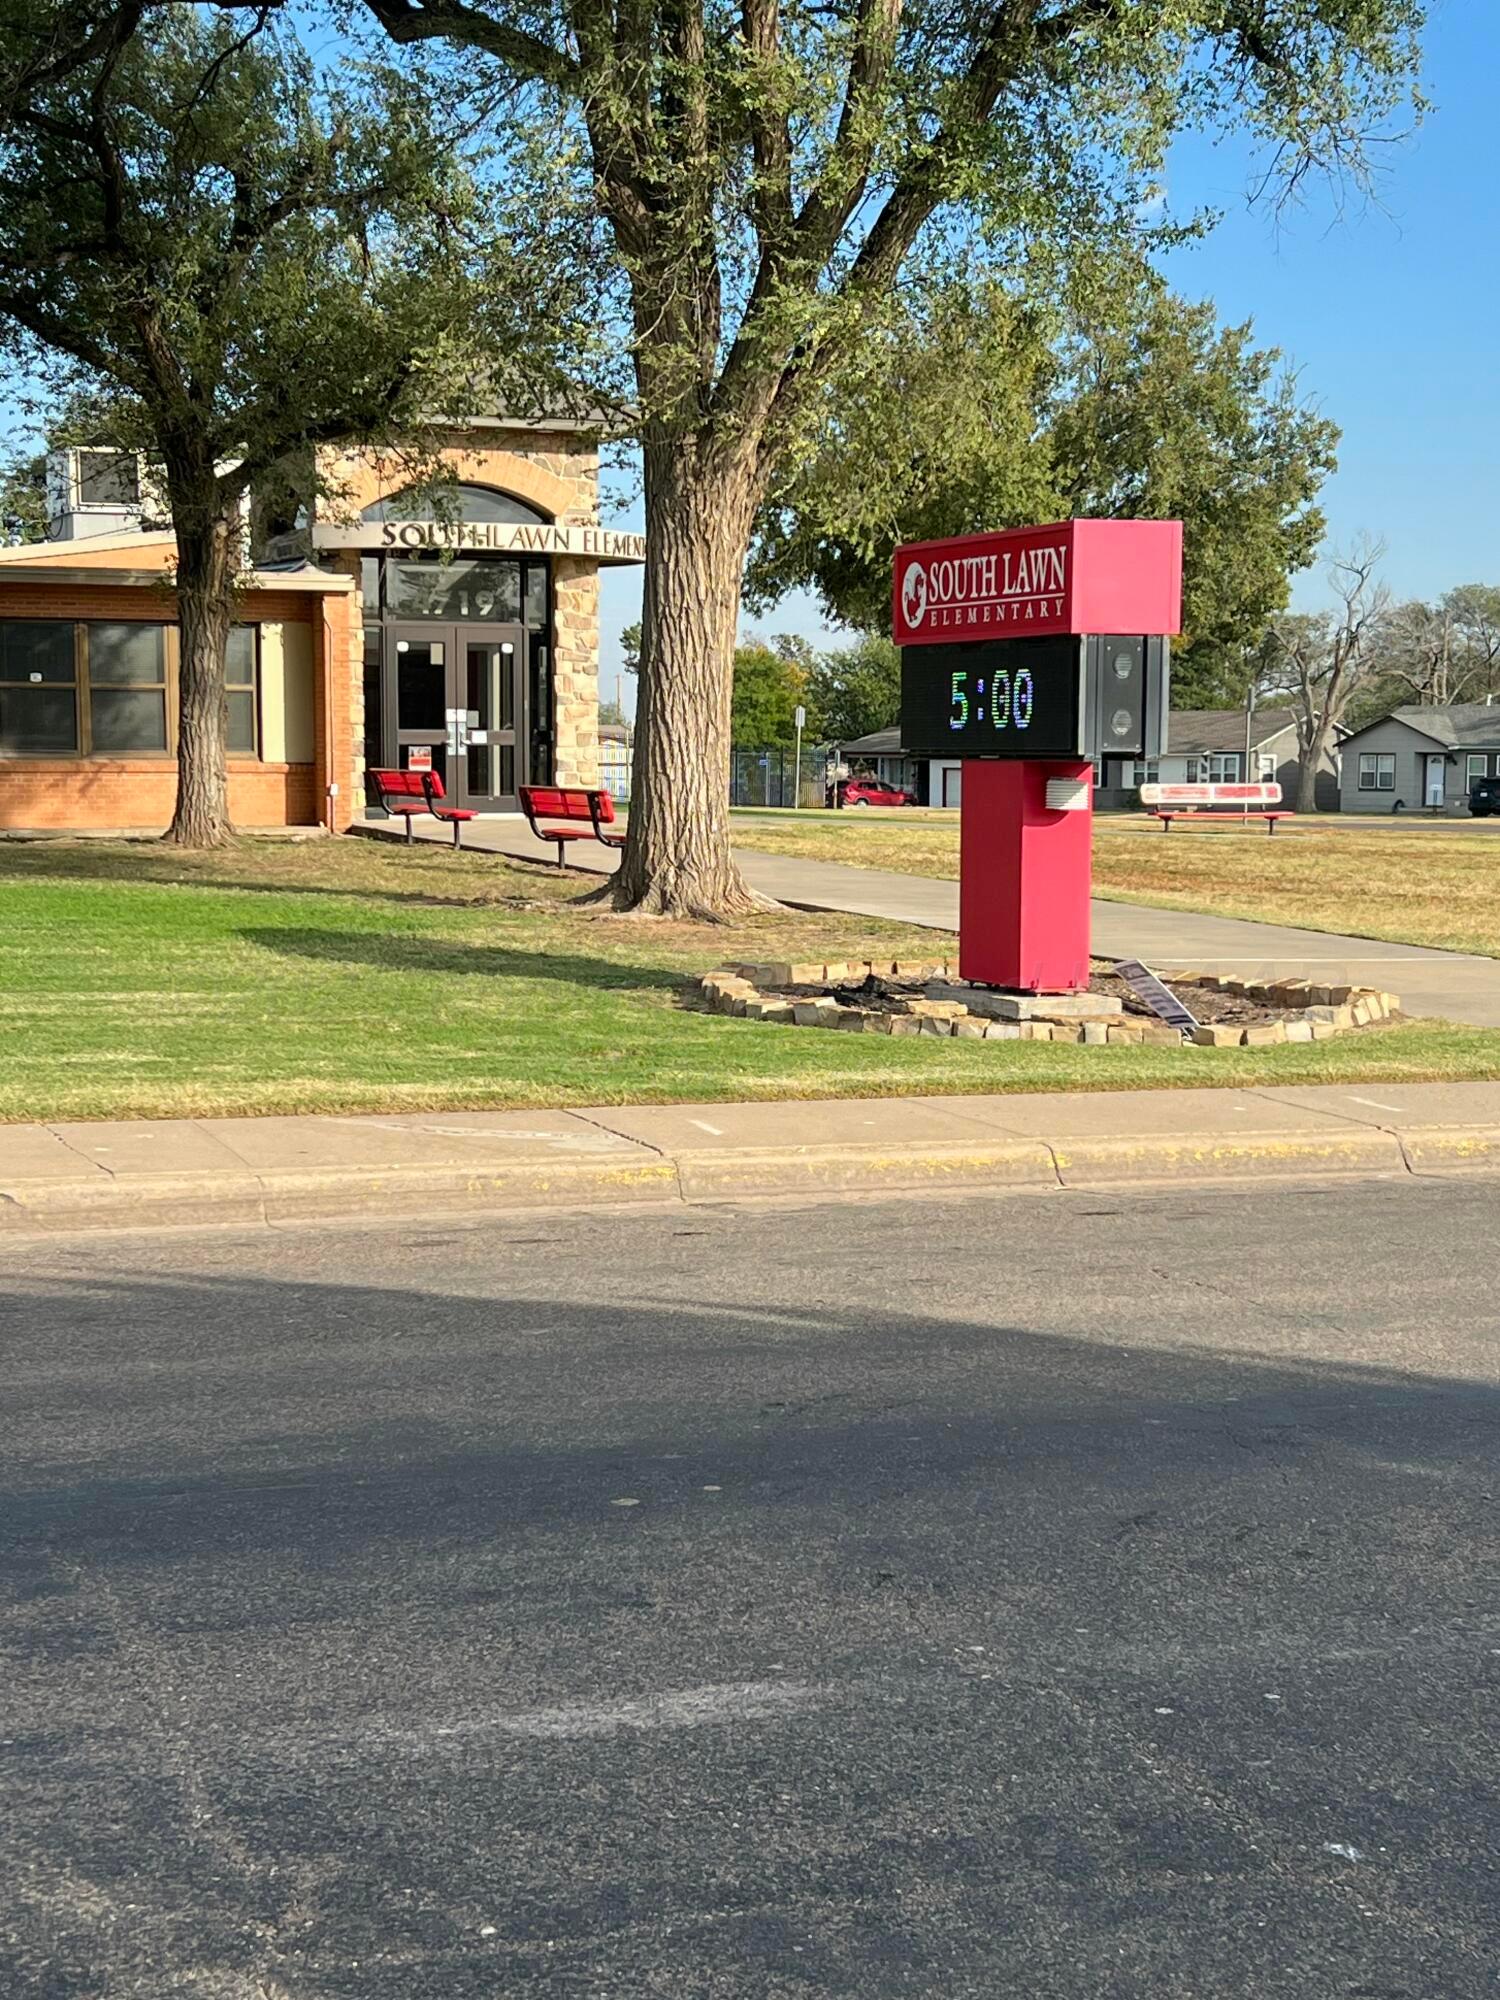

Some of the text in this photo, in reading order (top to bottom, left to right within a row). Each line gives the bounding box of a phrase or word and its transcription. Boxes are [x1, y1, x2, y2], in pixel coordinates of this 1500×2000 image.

[929, 546, 1067, 603] SOUTH LAWN
[930, 599, 1064, 627] ELEMENTARY
[950, 668, 1033, 730] 5:00
